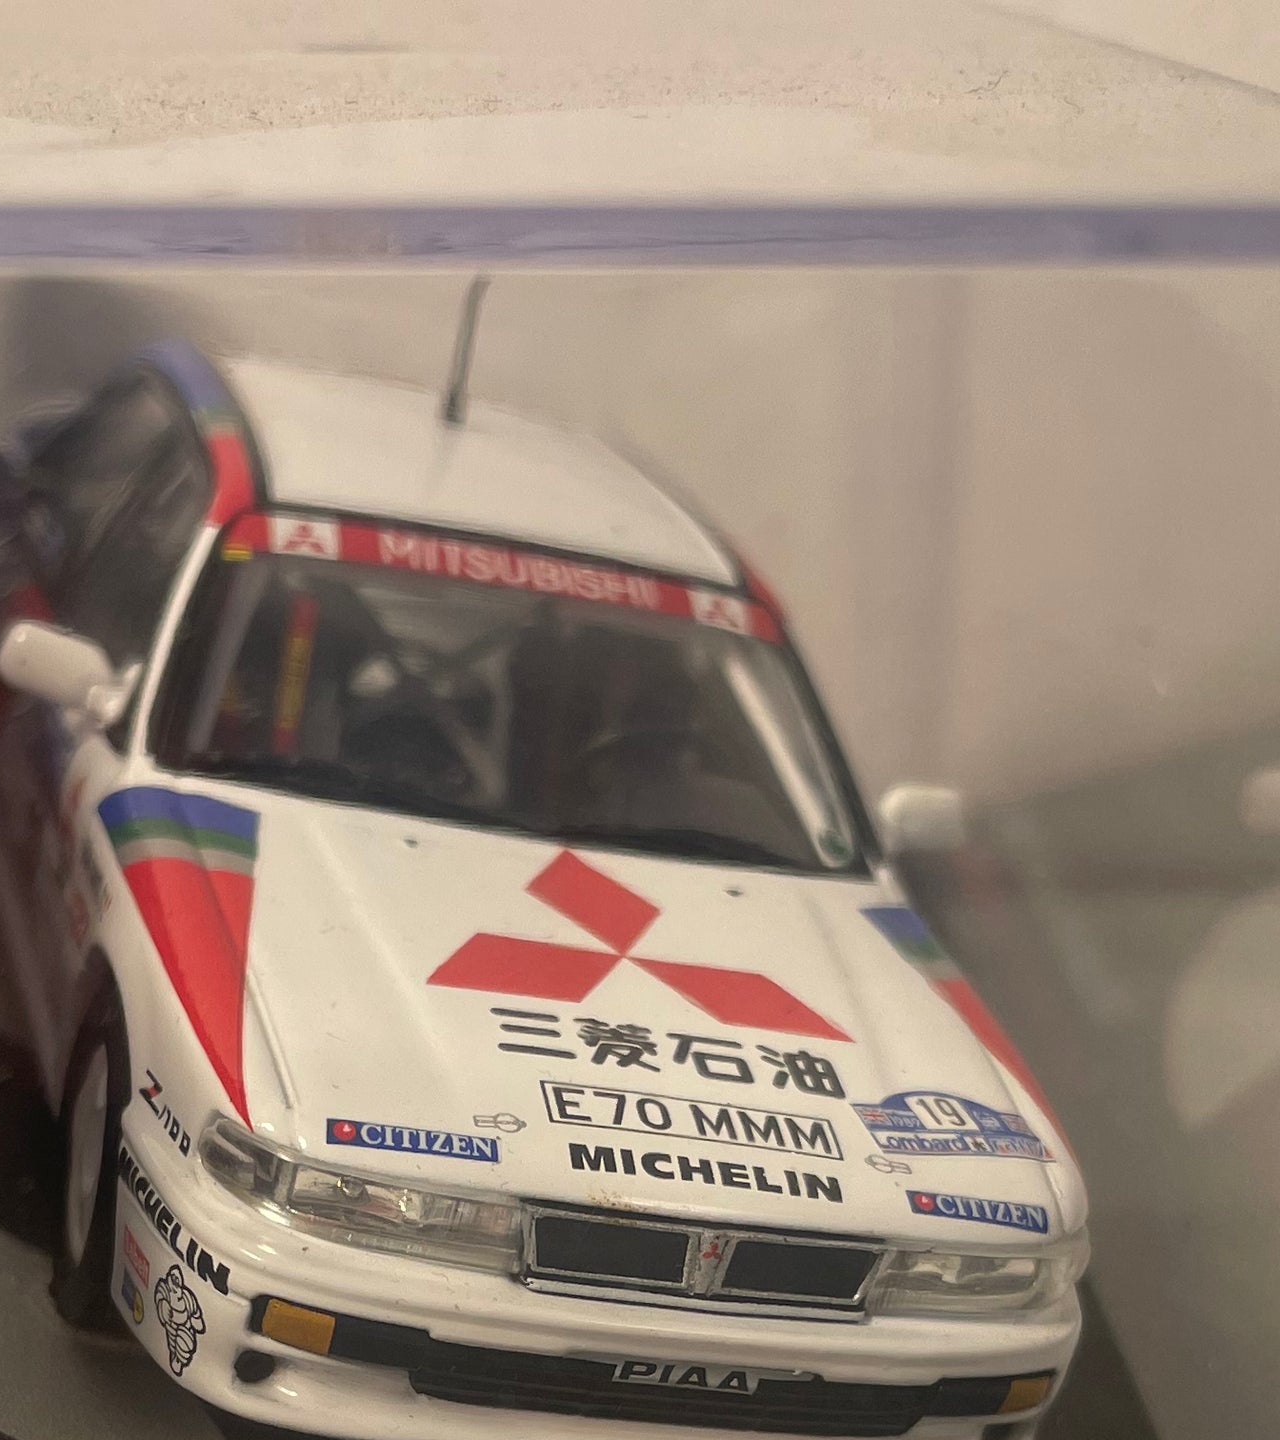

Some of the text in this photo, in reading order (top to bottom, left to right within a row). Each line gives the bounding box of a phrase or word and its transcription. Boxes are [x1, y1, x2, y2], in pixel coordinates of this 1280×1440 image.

[377, 529, 662, 610] MITSUBISHI
[489, 1006, 847, 1100] 三菱石油
[550, 1085, 833, 1155] E70 MMM
[915, 1097, 967, 1127] 19
[359, 1122, 495, 1160] CITIZEN
[871, 1131, 969, 1151] Lombard
[568, 1141, 845, 1204] MICHELIN
[118, 1145, 232, 1297] MICHELIN
[934, 1193, 1047, 1230] CITIZEN
[618, 1360, 752, 1394] PIAA
